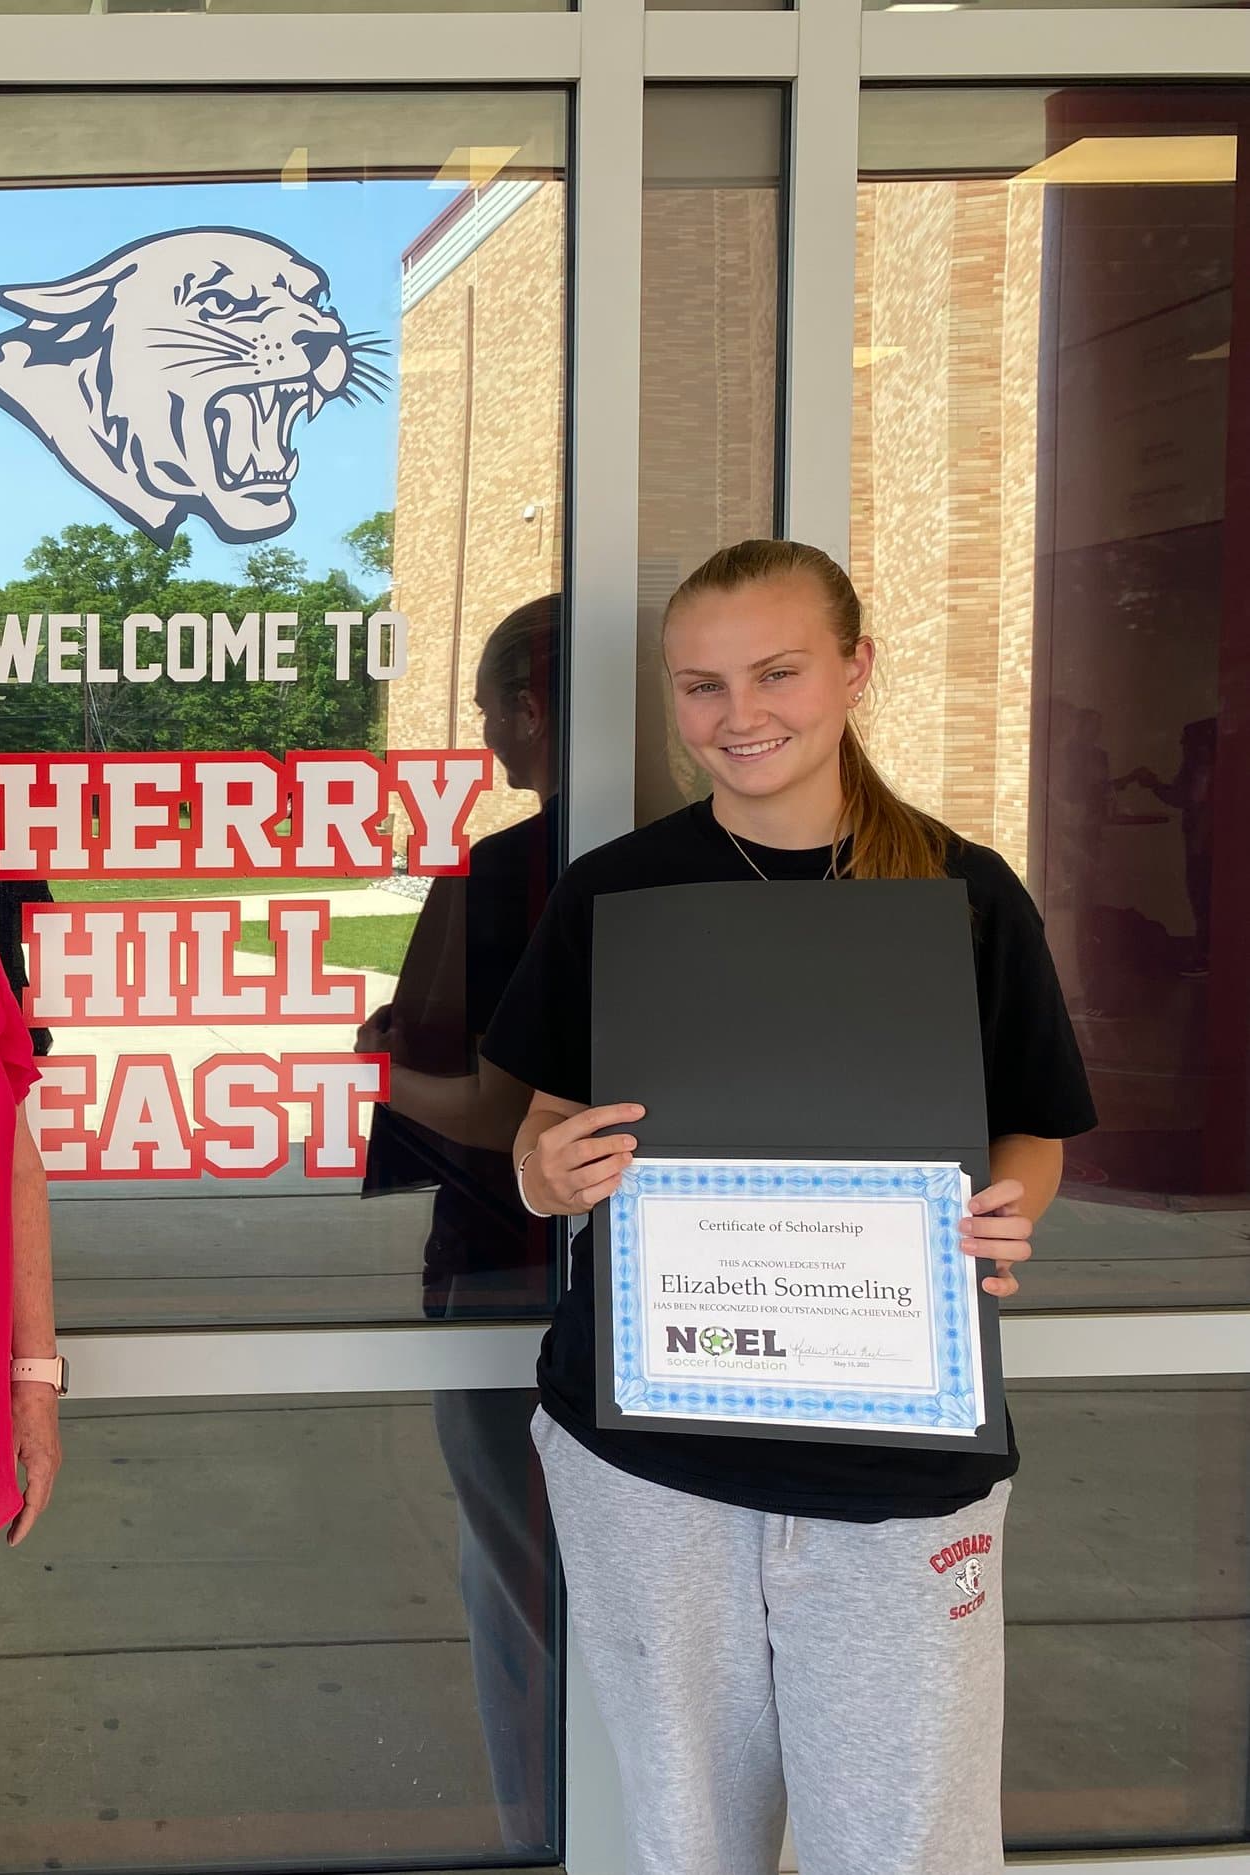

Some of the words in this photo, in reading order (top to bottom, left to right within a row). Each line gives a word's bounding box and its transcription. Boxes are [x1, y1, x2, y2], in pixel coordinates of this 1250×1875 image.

[325, 611, 408, 682] TO
[21, 900, 365, 1026] HILL
[26, 1052, 390, 1180] EAST
[698, 1219, 766, 1232] Certificate
[769, 1220, 782, 1232] of
[785, 1220, 864, 1237] Scholarship
[718, 1259, 740, 1268] THIS
[741, 1260, 820, 1270] ACKNOWLEDGES
[820, 1261, 847, 1270] THAT
[660, 1274, 768, 1296] Elizabeth
[774, 1277, 912, 1307] Sommeling
[653, 1301, 673, 1310] HAS
[673, 1302, 697, 1311] BEEN
[699, 1303, 759, 1313] RECOGNIZED
[760, 1305, 778, 1313] FOR
[779, 1305, 850, 1316] OUTSTANDING
[851, 1308, 921, 1318] ACHIEVEMENT
[668, 1357, 712, 1368] soccer
[713, 1357, 787, 1371] foundation
[930, 1533, 993, 1575] COUGARS
[949, 1590, 986, 1621] SOCCER
